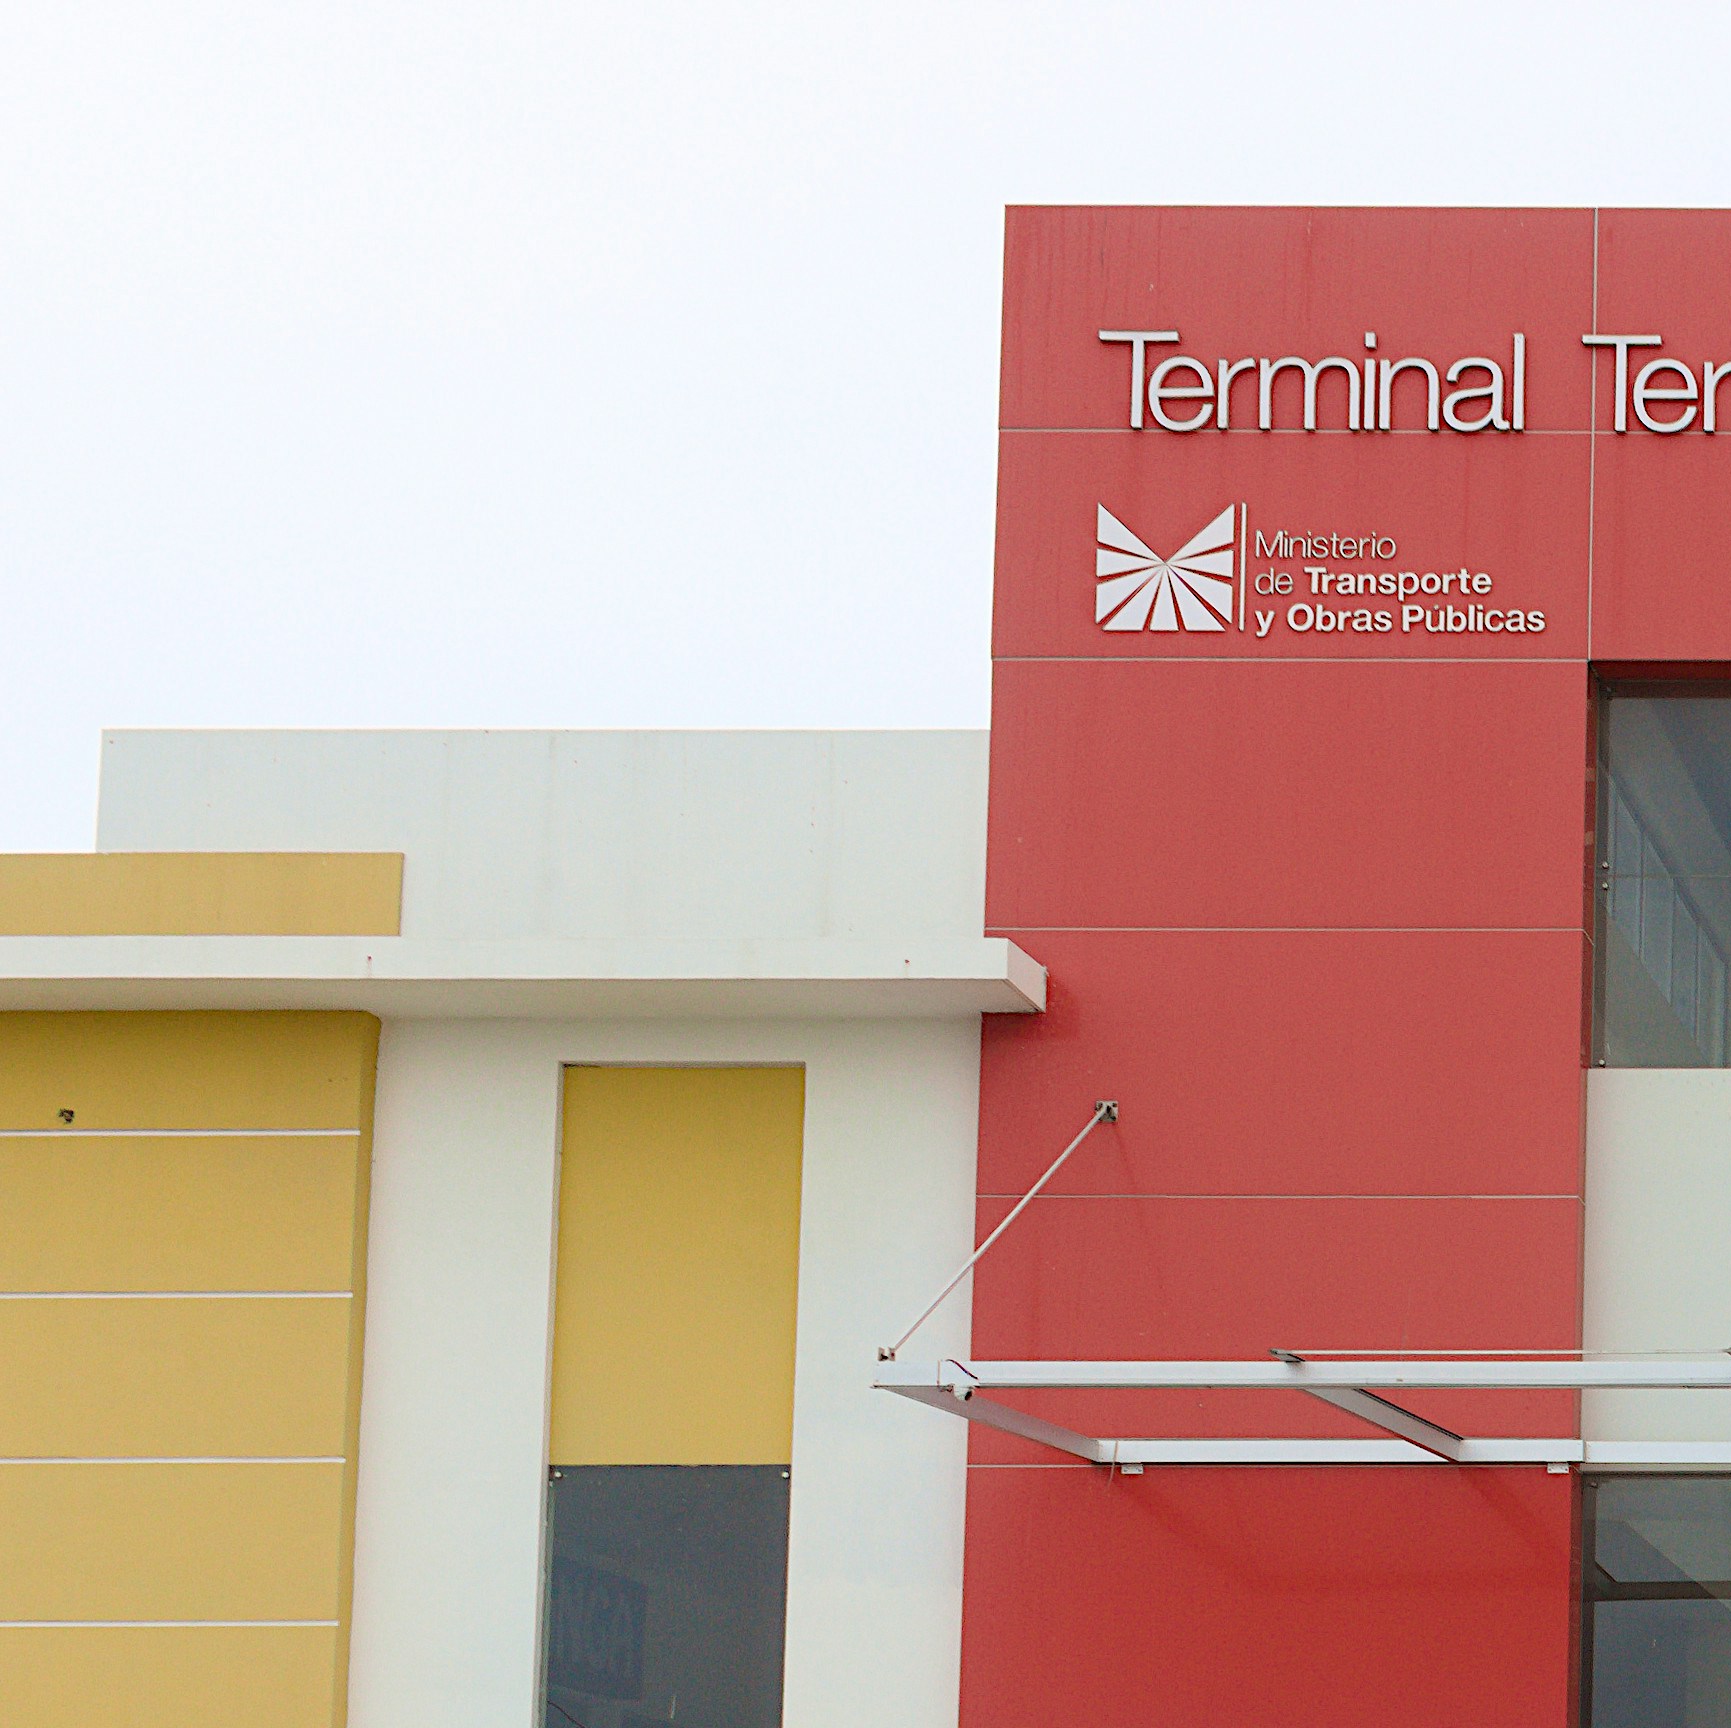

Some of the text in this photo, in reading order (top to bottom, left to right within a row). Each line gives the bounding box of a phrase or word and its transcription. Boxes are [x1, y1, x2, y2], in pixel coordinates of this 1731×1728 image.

[1097, 328, 1526, 433] Terminal
[1254, 529, 1398, 560] Ministerio
[1253, 565, 1493, 602] de Transporte
[1254, 608, 1276, 638] y
[1286, 602, 1393, 633] Obras
